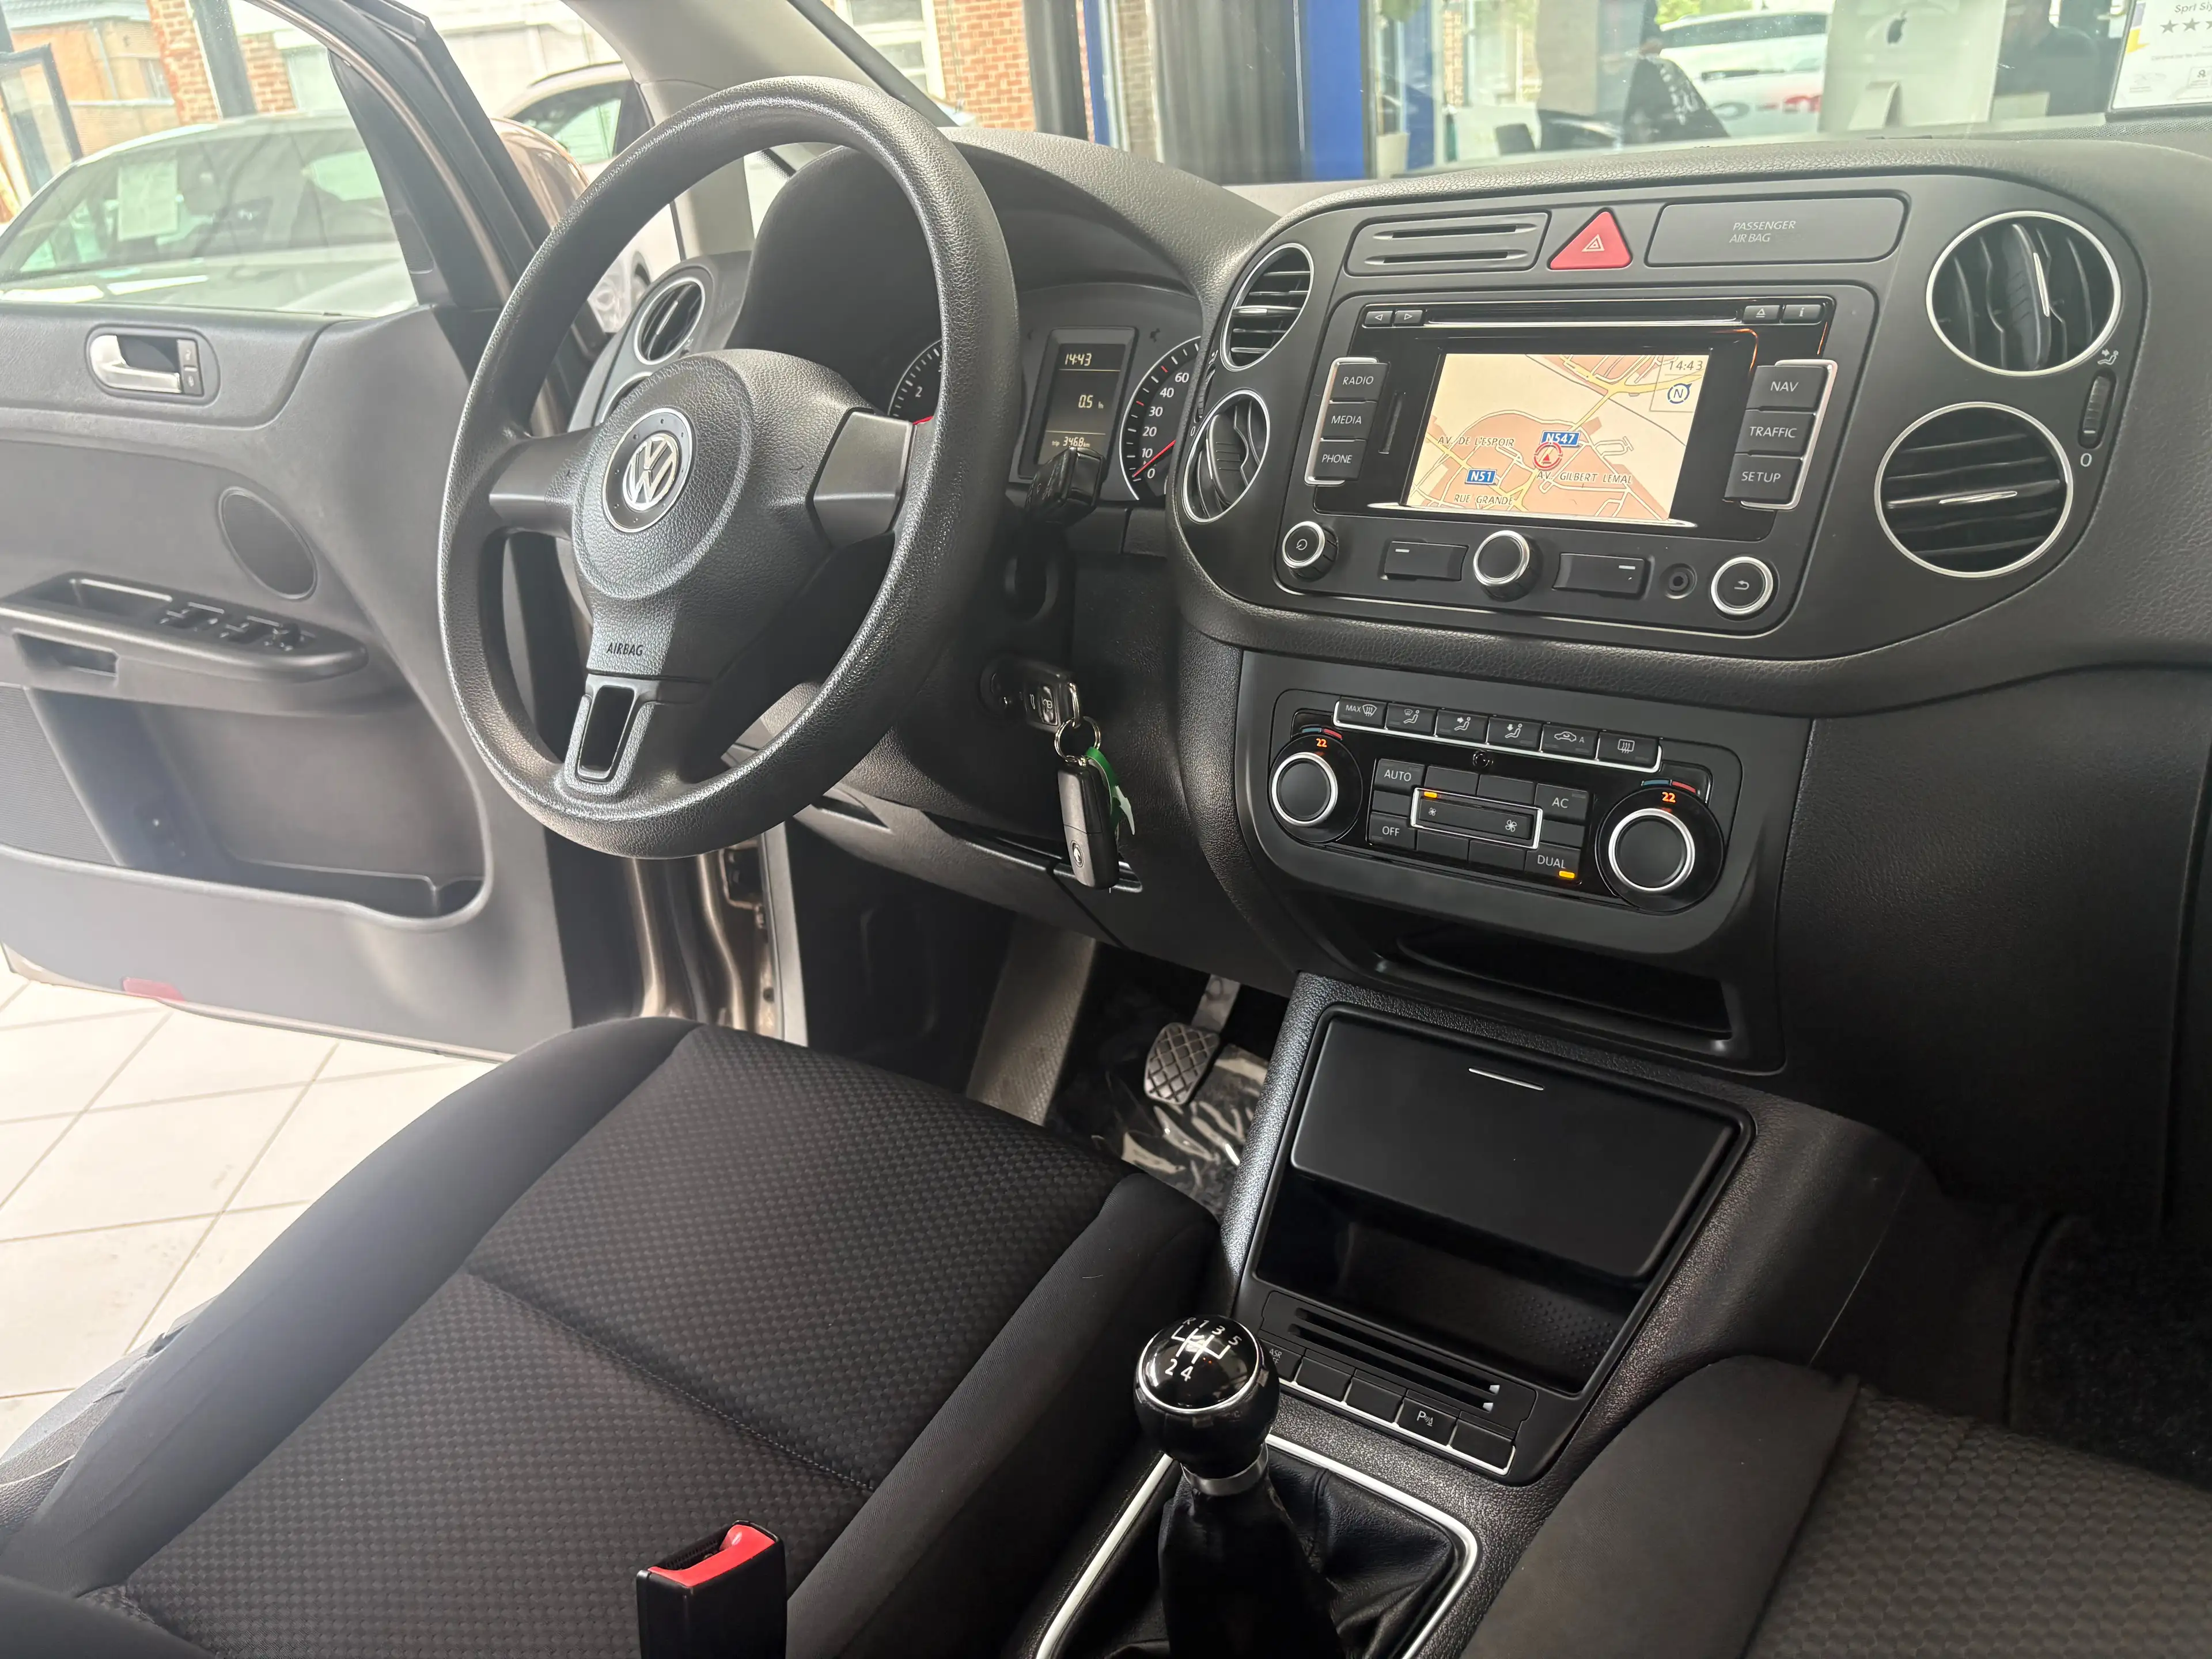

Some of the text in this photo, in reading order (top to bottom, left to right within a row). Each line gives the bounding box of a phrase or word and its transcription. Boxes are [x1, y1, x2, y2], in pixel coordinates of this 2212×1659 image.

[2174, 3, 2197, 14] Sprl
[1733, 221, 1796, 230] PASSENGER
[1729, 233, 1771, 243] AIR BAG
[1065, 353, 1092, 366] 14:43
[1669, 360, 1703, 370] 14:43
[1175, 372, 1190, 382] 60
[1343, 376, 1374, 385] RADIO
[915, 385, 923, 397] 2
[1160, 387, 1175, 397] 40
[1770, 381, 1799, 392] NAV
[1673, 389, 1684, 398] N
[1078, 394, 1094, 408] 0.5
[1149, 406, 1163, 416] 30
[1331, 415, 1362, 424] MEDIA
[1142, 426, 1157, 437] 20
[1190, 426, 1196, 436] 0
[1749, 426, 1797, 438] TRAFFIC
[1458, 437, 1471, 445] DE
[1475, 437, 1514, 446] L'ESPOIR
[1546, 433, 1575, 444] N547
[1142, 448, 1153, 458] 10
[1321, 454, 1353, 463] PHONE
[2080, 453, 2092, 467] 0
[1147, 468, 1156, 479] 0
[1470, 473, 1492, 482] N51
[1560, 472, 1598, 482] GILBERT
[1603, 474, 1632, 484] LEMAL
[1741, 471, 1781, 483] SETUP
[1454, 494, 1513, 505] RUE GRANDE
[607, 642, 643, 656] AIRBAG
[1345, 704, 1361, 713] MAX
[1316, 738, 1327, 748] 22
[1384, 769, 1411, 782] AUTO
[1552, 797, 1569, 808] AC
[1661, 791, 1676, 803] 22
[1382, 826, 1400, 836] OFF
[1537, 855, 1566, 869] DUAL
[1183, 1317, 1242, 1346] R 1 3 5
[1269, 1348, 1282, 1358] ASR
[1165, 1358, 1194, 1382] 2 4
[1416, 1410, 1426, 1421] P
